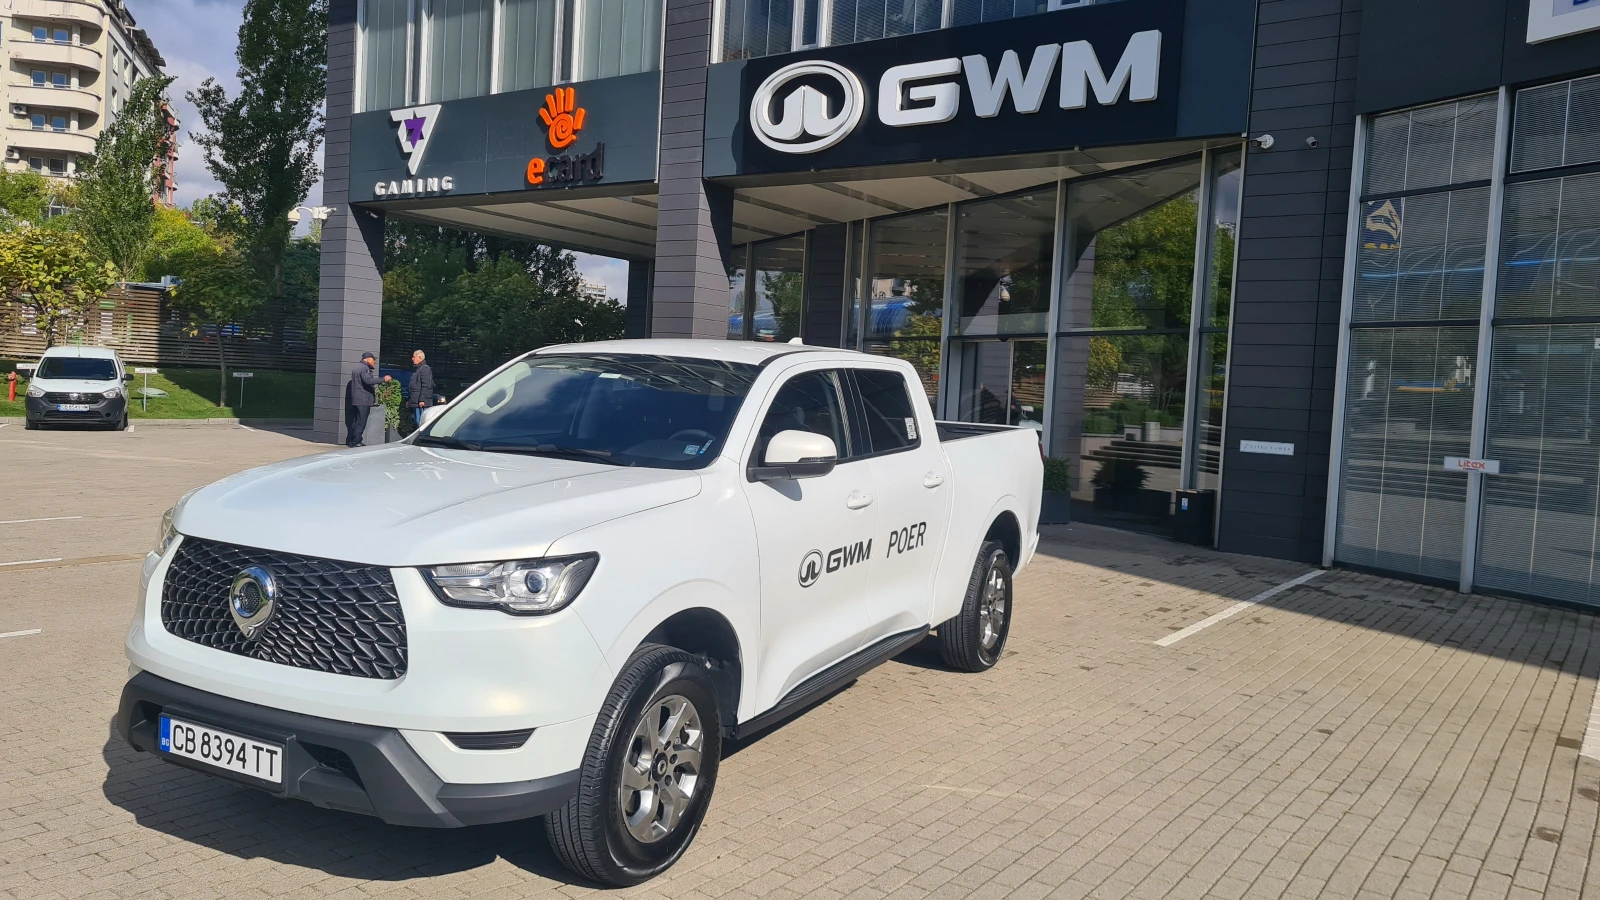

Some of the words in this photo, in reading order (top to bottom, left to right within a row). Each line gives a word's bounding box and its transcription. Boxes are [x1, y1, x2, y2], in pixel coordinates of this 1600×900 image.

[877, 29, 1162, 127] GWM
[374, 176, 454, 196] GAMING
[526, 141, 605, 185] ecard
[1458, 459, 1486, 469] Litex
[825, 538, 873, 573] GWM
[886, 521, 927, 559] POER
[173, 724, 196, 754] CB
[200, 731, 247, 769] 8394
[252, 745, 278, 777] TT
